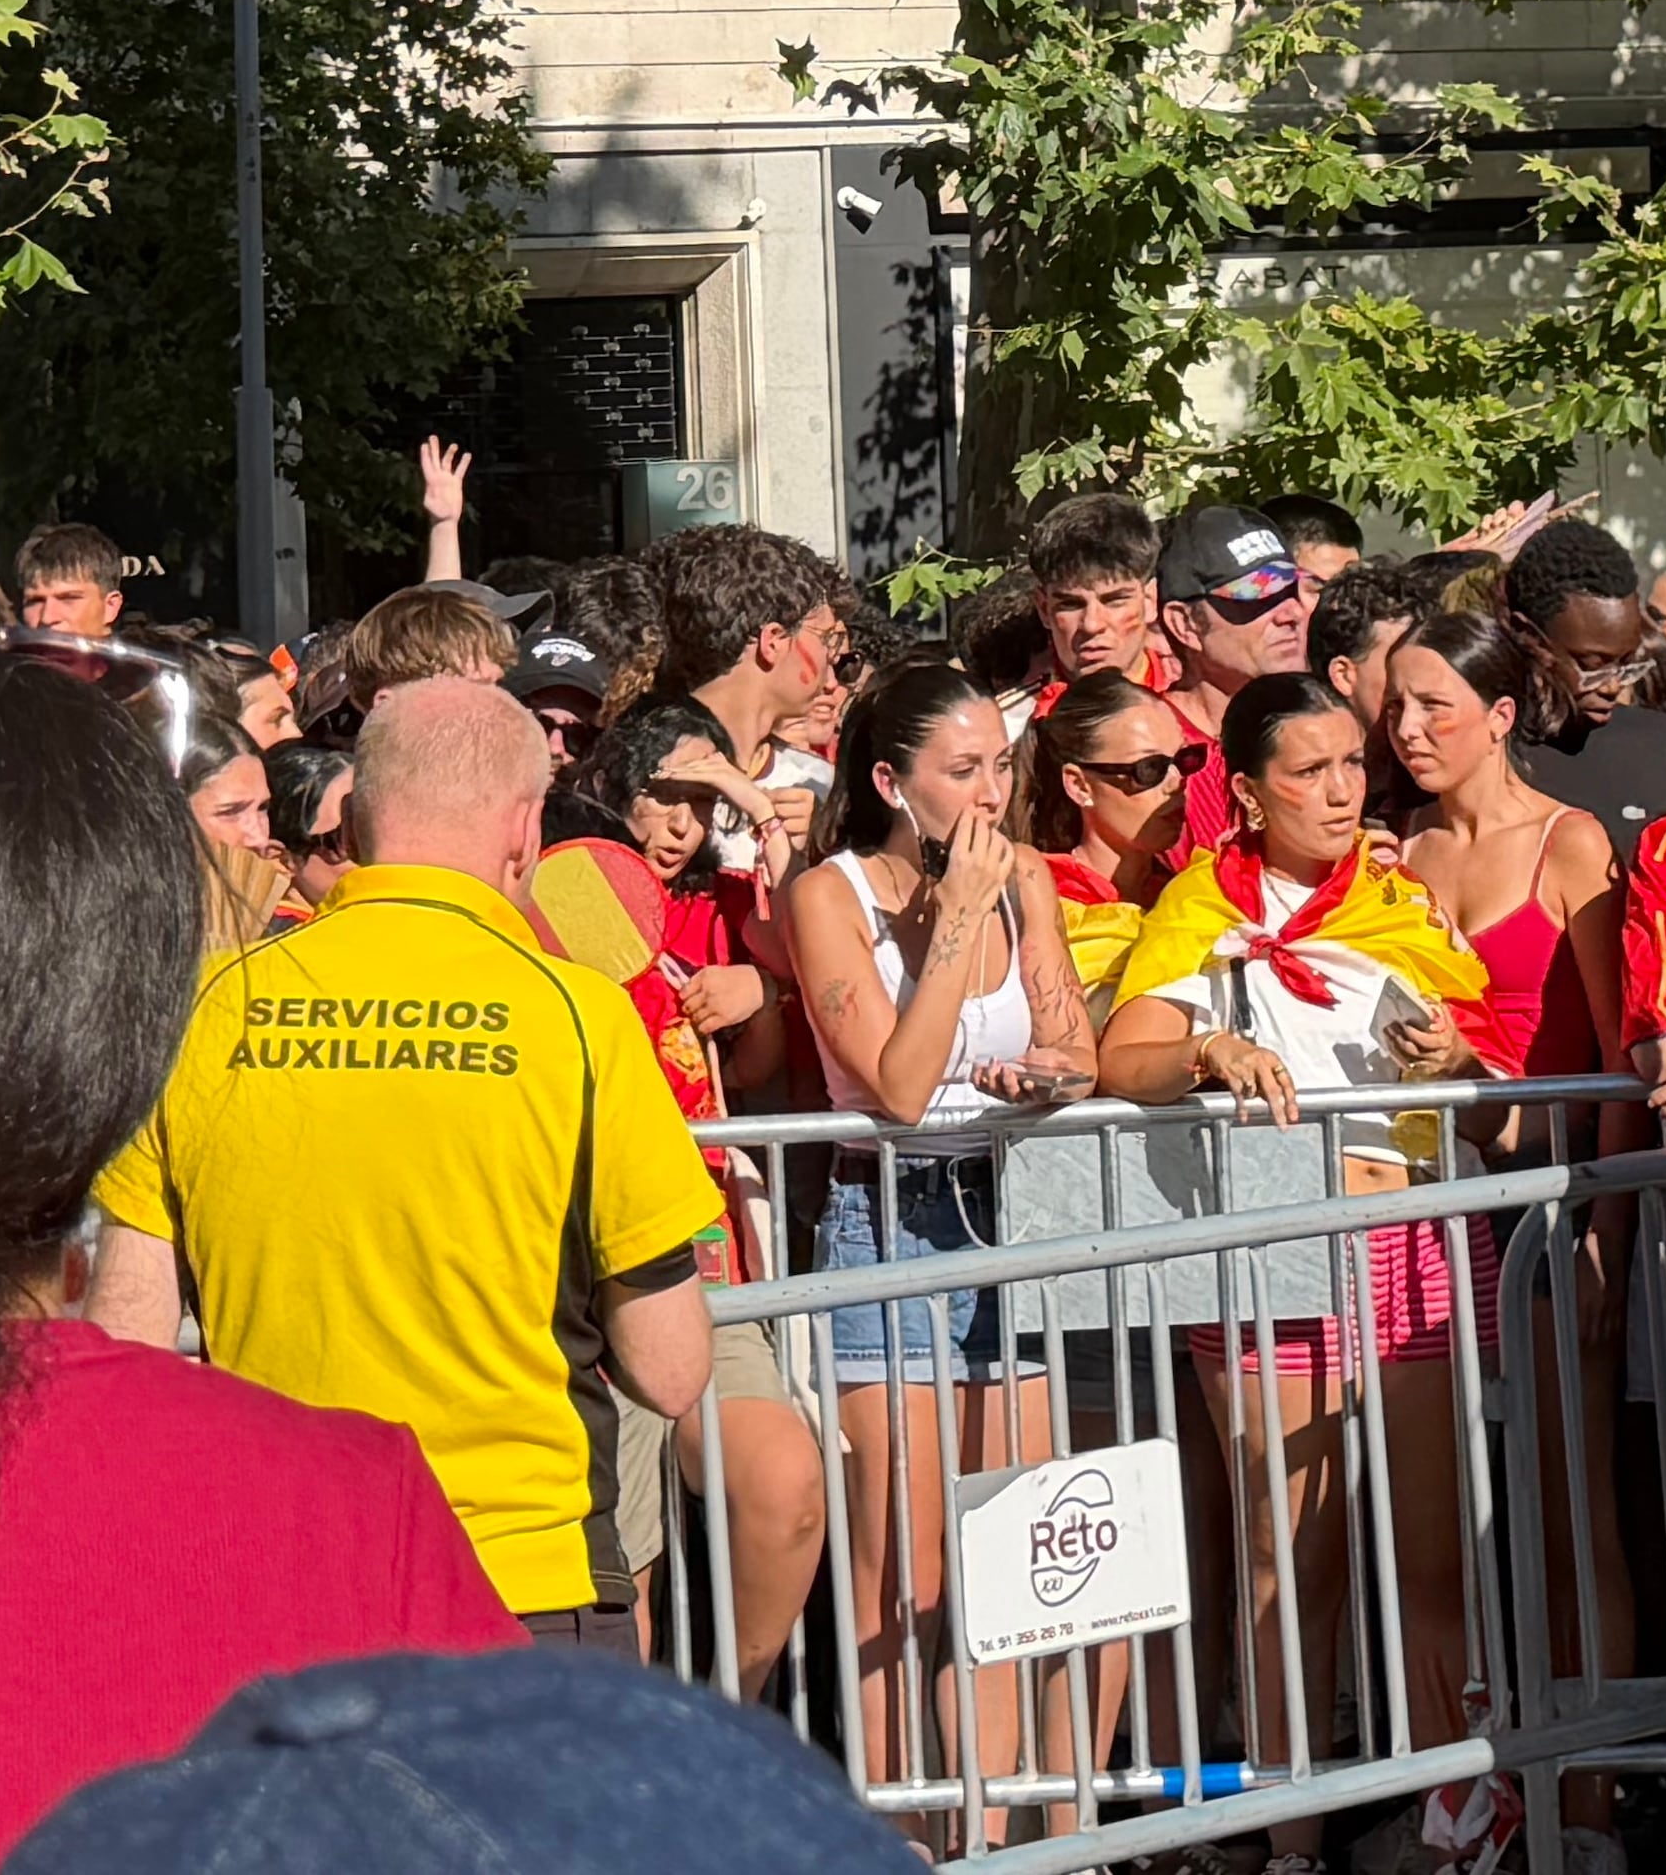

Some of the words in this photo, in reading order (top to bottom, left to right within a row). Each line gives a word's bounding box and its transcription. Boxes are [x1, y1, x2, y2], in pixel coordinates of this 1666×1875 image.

[1196, 265, 1345, 290] RABAT
[676, 466, 734, 511] 26
[245, 997, 511, 1033] SERVICIOS
[225, 1038, 520, 1077] AUXILIARES
[1030, 1511, 1119, 1566] Reto
